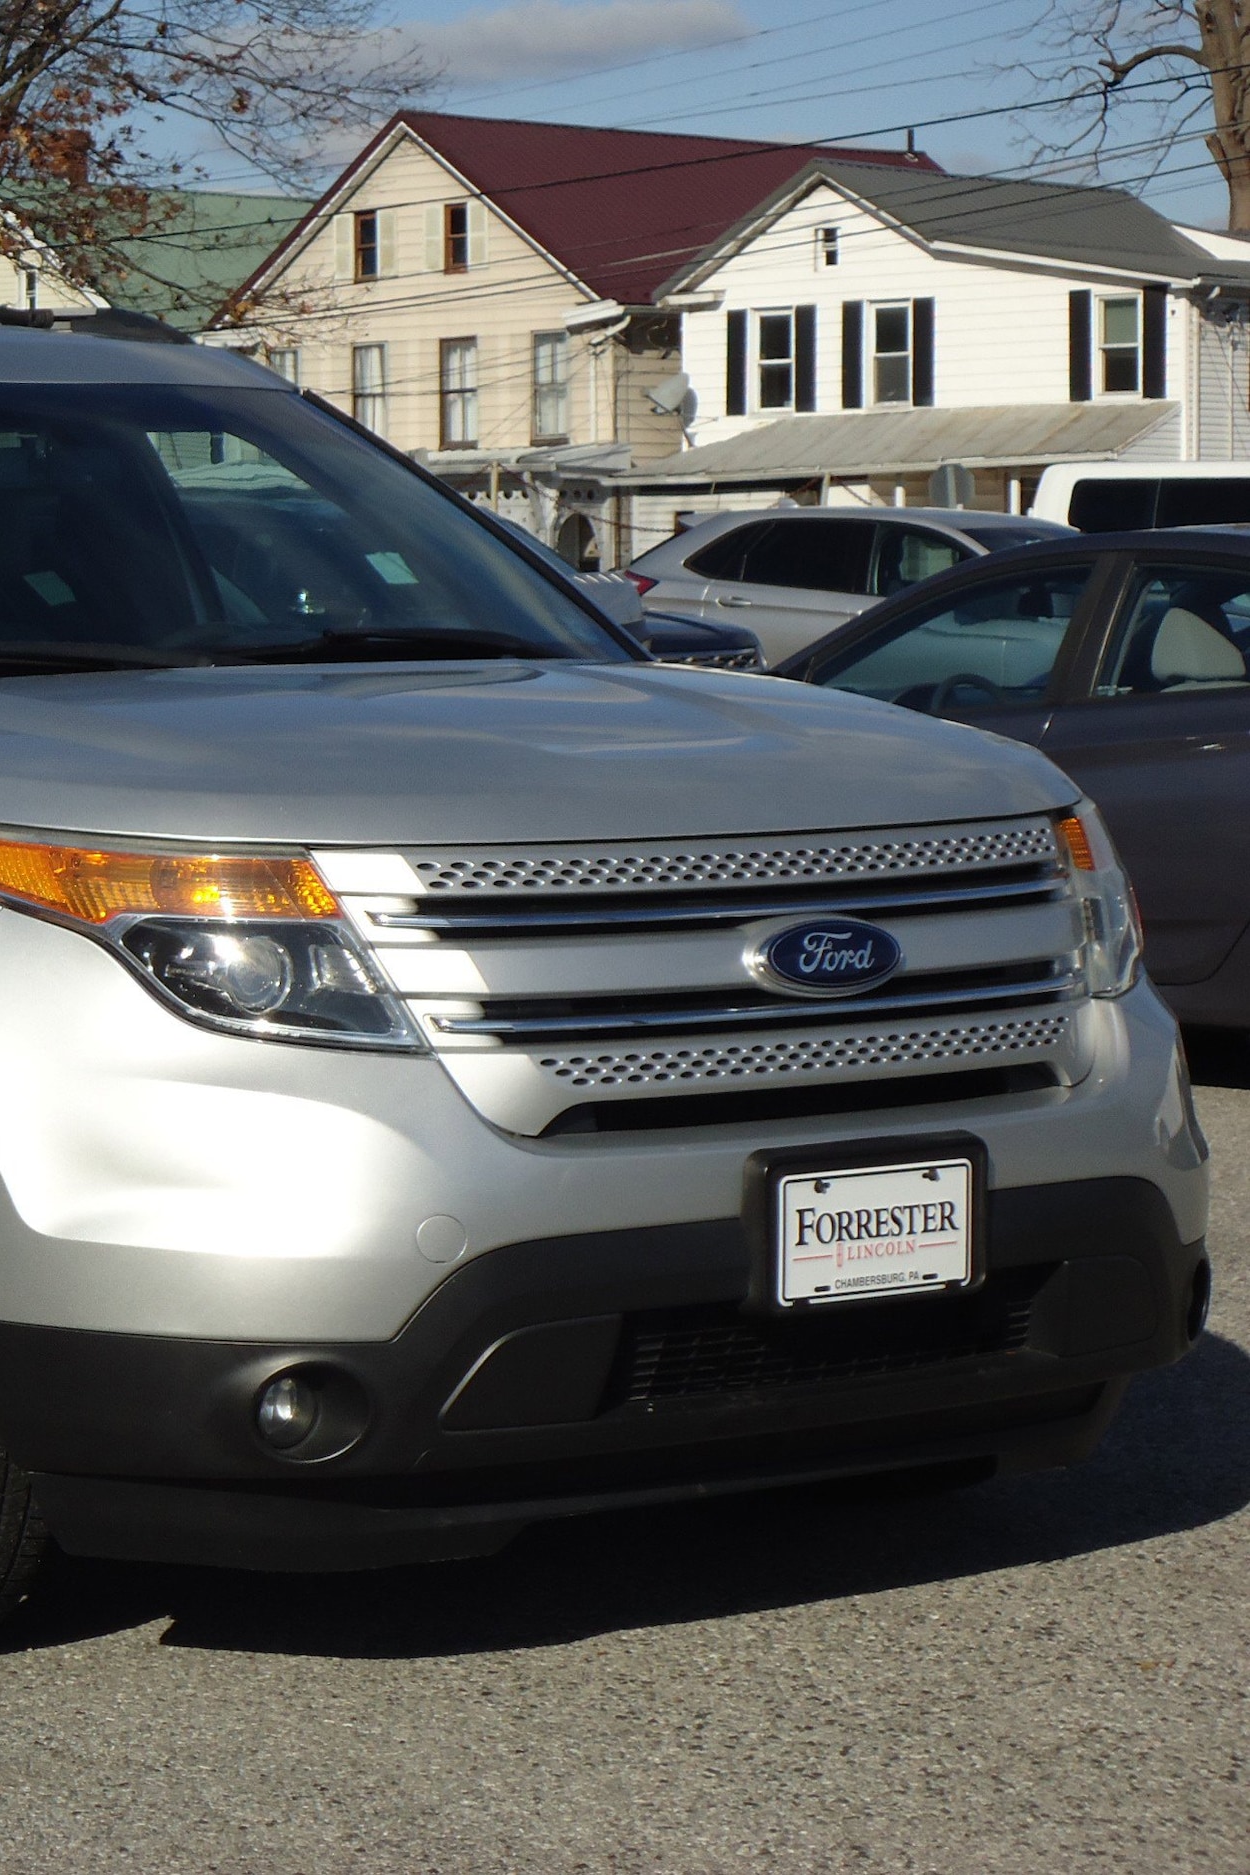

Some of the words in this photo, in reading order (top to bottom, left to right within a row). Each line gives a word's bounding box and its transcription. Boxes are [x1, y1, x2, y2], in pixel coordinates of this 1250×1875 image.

[799, 931, 875, 972] Ford
[795, 1201, 959, 1246] FORRESTER
[847, 1240, 916, 1260] LINCOLN
[835, 1273, 906, 1289] CHAMBERSBURG,
[908, 1271, 919, 1281] PA
